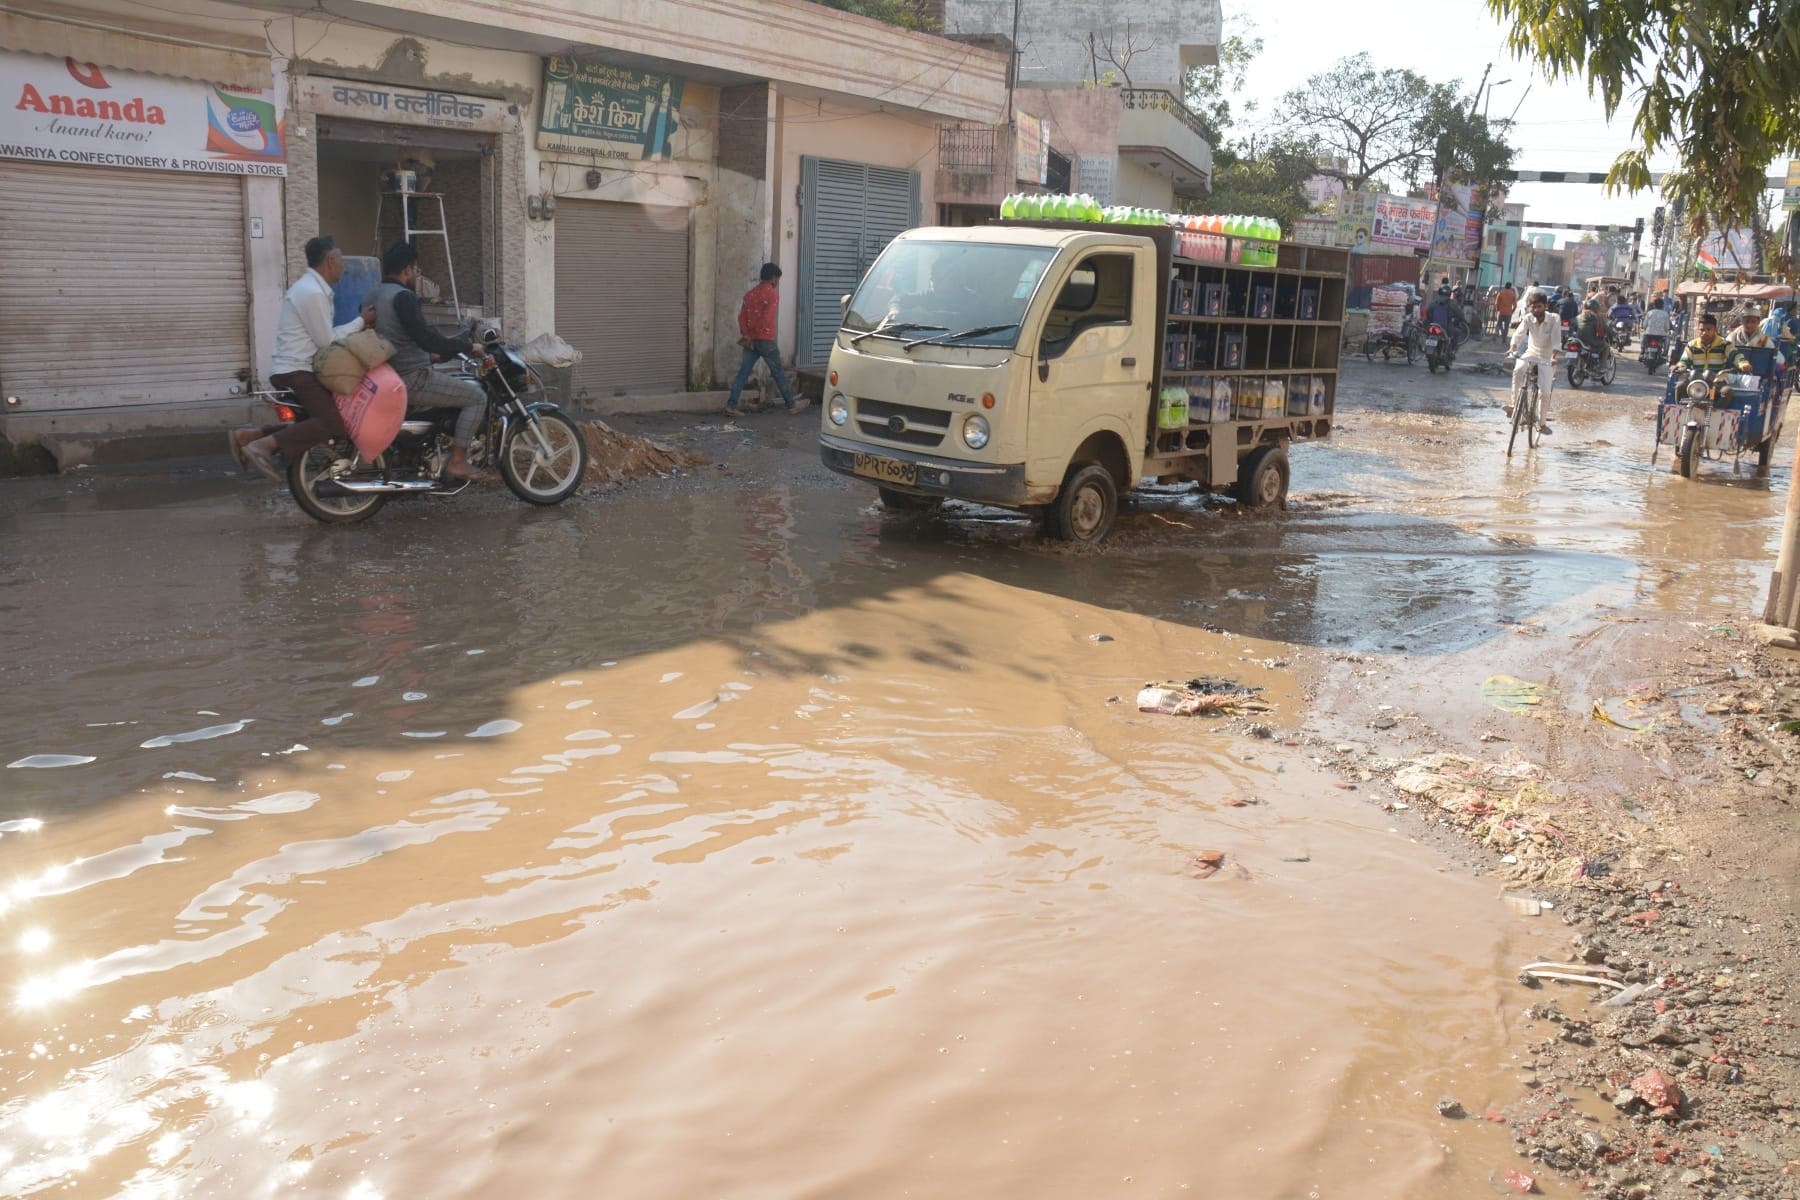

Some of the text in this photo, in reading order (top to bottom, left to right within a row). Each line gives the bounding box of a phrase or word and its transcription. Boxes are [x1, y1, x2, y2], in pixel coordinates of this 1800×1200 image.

[15, 83, 166, 125] Ananda
[394, 92, 485, 119] क्लीनिक
[573, 96, 644, 130] केश किंग
[34, 118, 153, 143] Anand karo!
[0, 144, 284, 176] WARIYA CONFECTIONERY & PROVISION STORE
[577, 146, 606, 156] GENERAL
[607, 150, 630, 159] STORE
[948, 393, 967, 402] ACE
